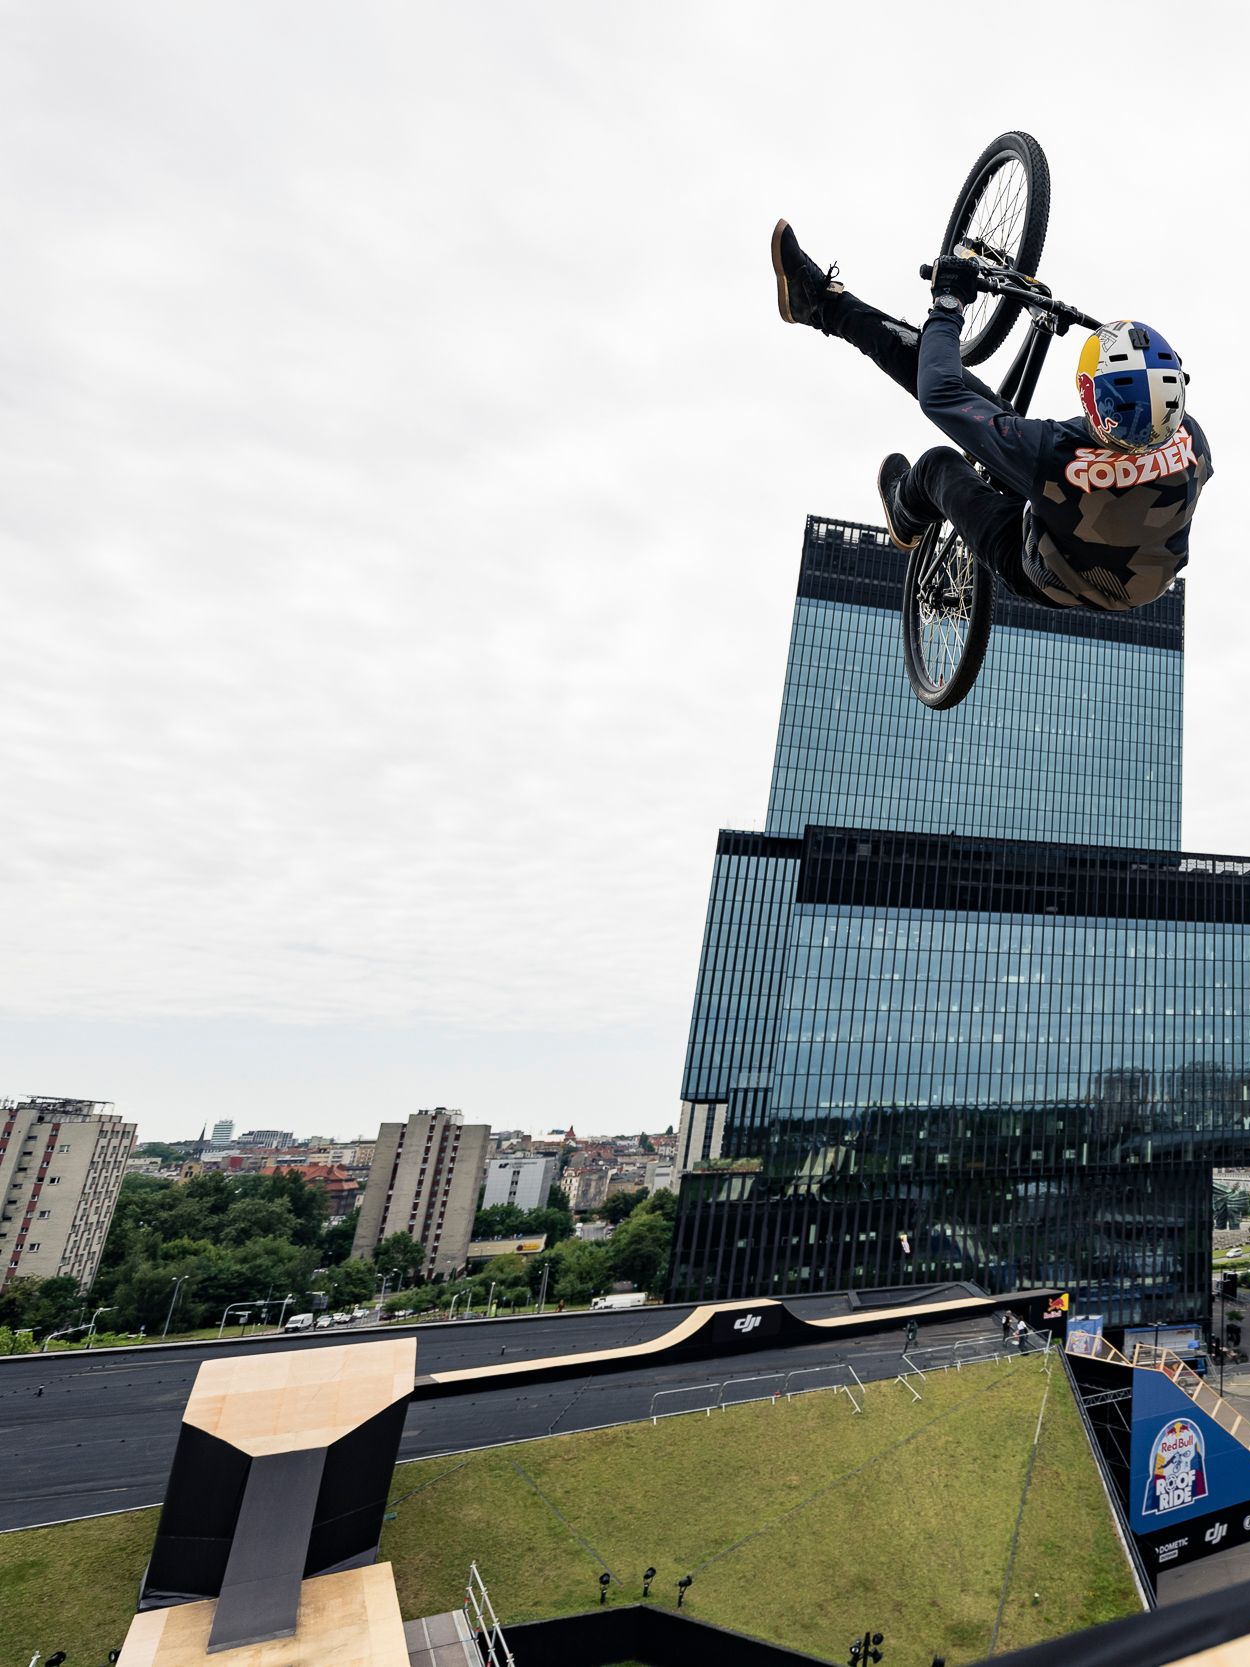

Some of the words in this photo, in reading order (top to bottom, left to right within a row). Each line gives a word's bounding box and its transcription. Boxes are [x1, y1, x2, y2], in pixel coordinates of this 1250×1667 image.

[1065, 435, 1198, 494] GODZIEK
[1161, 1440, 1178, 1453] Red
[1179, 1434, 1194, 1449] Bull
[1156, 1469, 1196, 1496] ROOF
[1160, 1487, 1192, 1511] RIDE
[1159, 1537, 1189, 1554] DOMETIC
